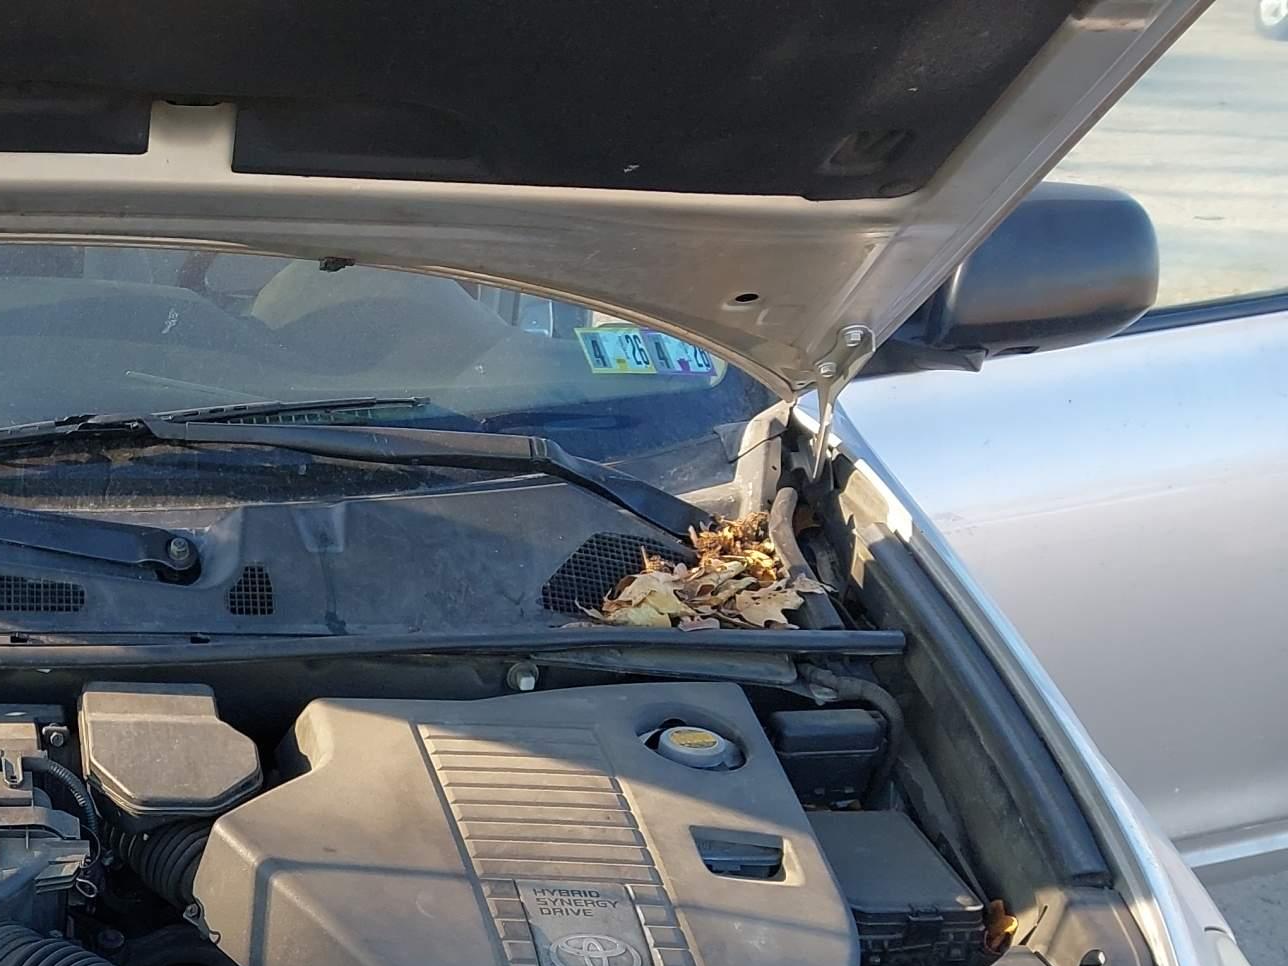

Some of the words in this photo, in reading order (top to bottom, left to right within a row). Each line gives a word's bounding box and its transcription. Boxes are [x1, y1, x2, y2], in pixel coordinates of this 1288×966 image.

[591, 339, 607, 367] 4
[624, 334, 650, 366] 26
[654, 341, 671, 368] 4
[533, 888, 600, 898] HYBRID
[535, 897, 618, 909] SYNERGY
[540, 907, 593, 917] DRIVE
